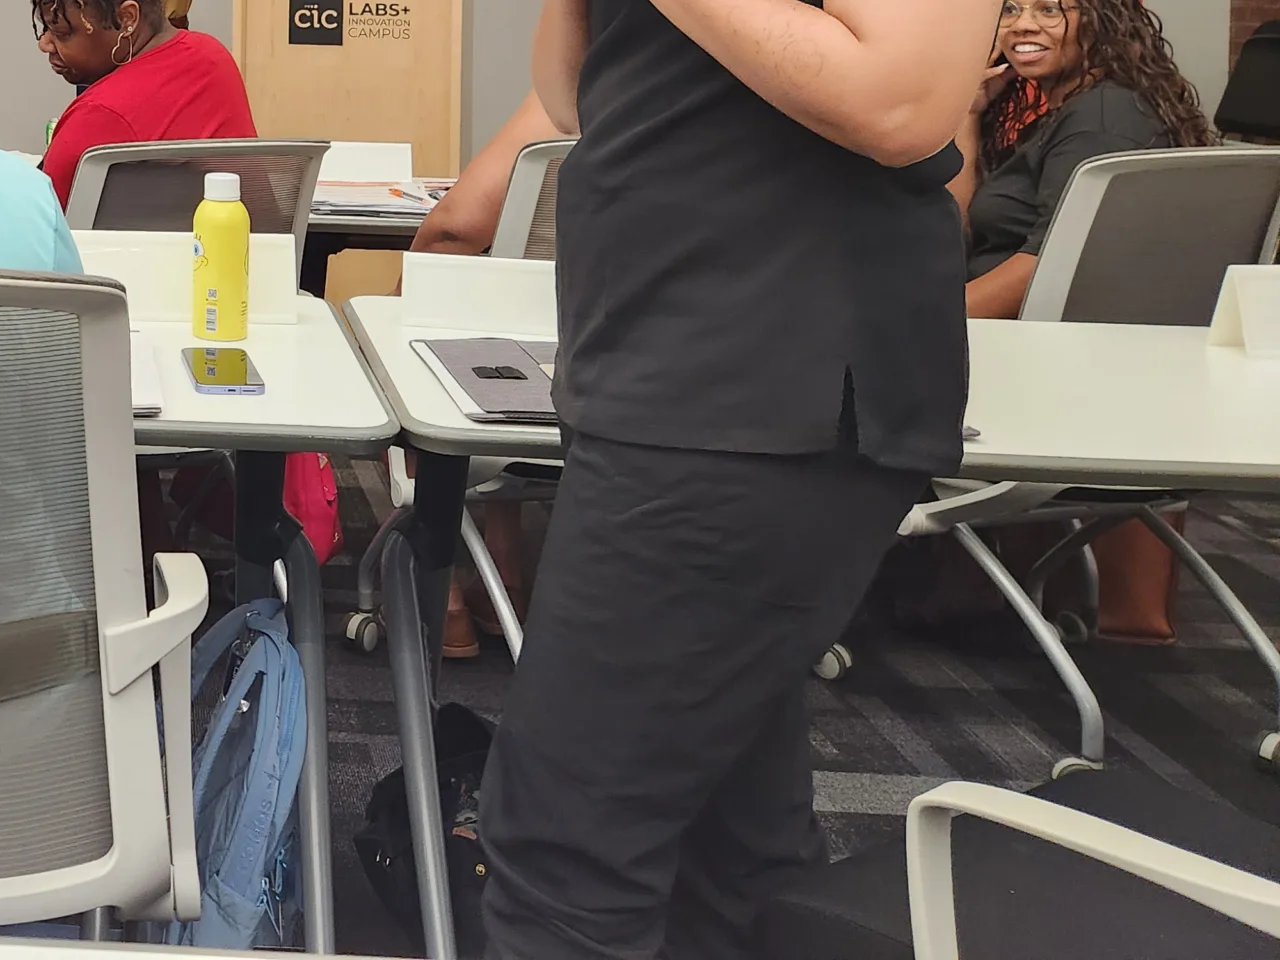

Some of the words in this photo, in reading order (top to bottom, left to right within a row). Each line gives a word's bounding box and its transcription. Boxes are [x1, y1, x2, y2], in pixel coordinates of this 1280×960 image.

[348, 2, 410, 17] LABS+
[348, 17, 411, 27] INNOVATION
[347, 27, 411, 40] CAMPUS
